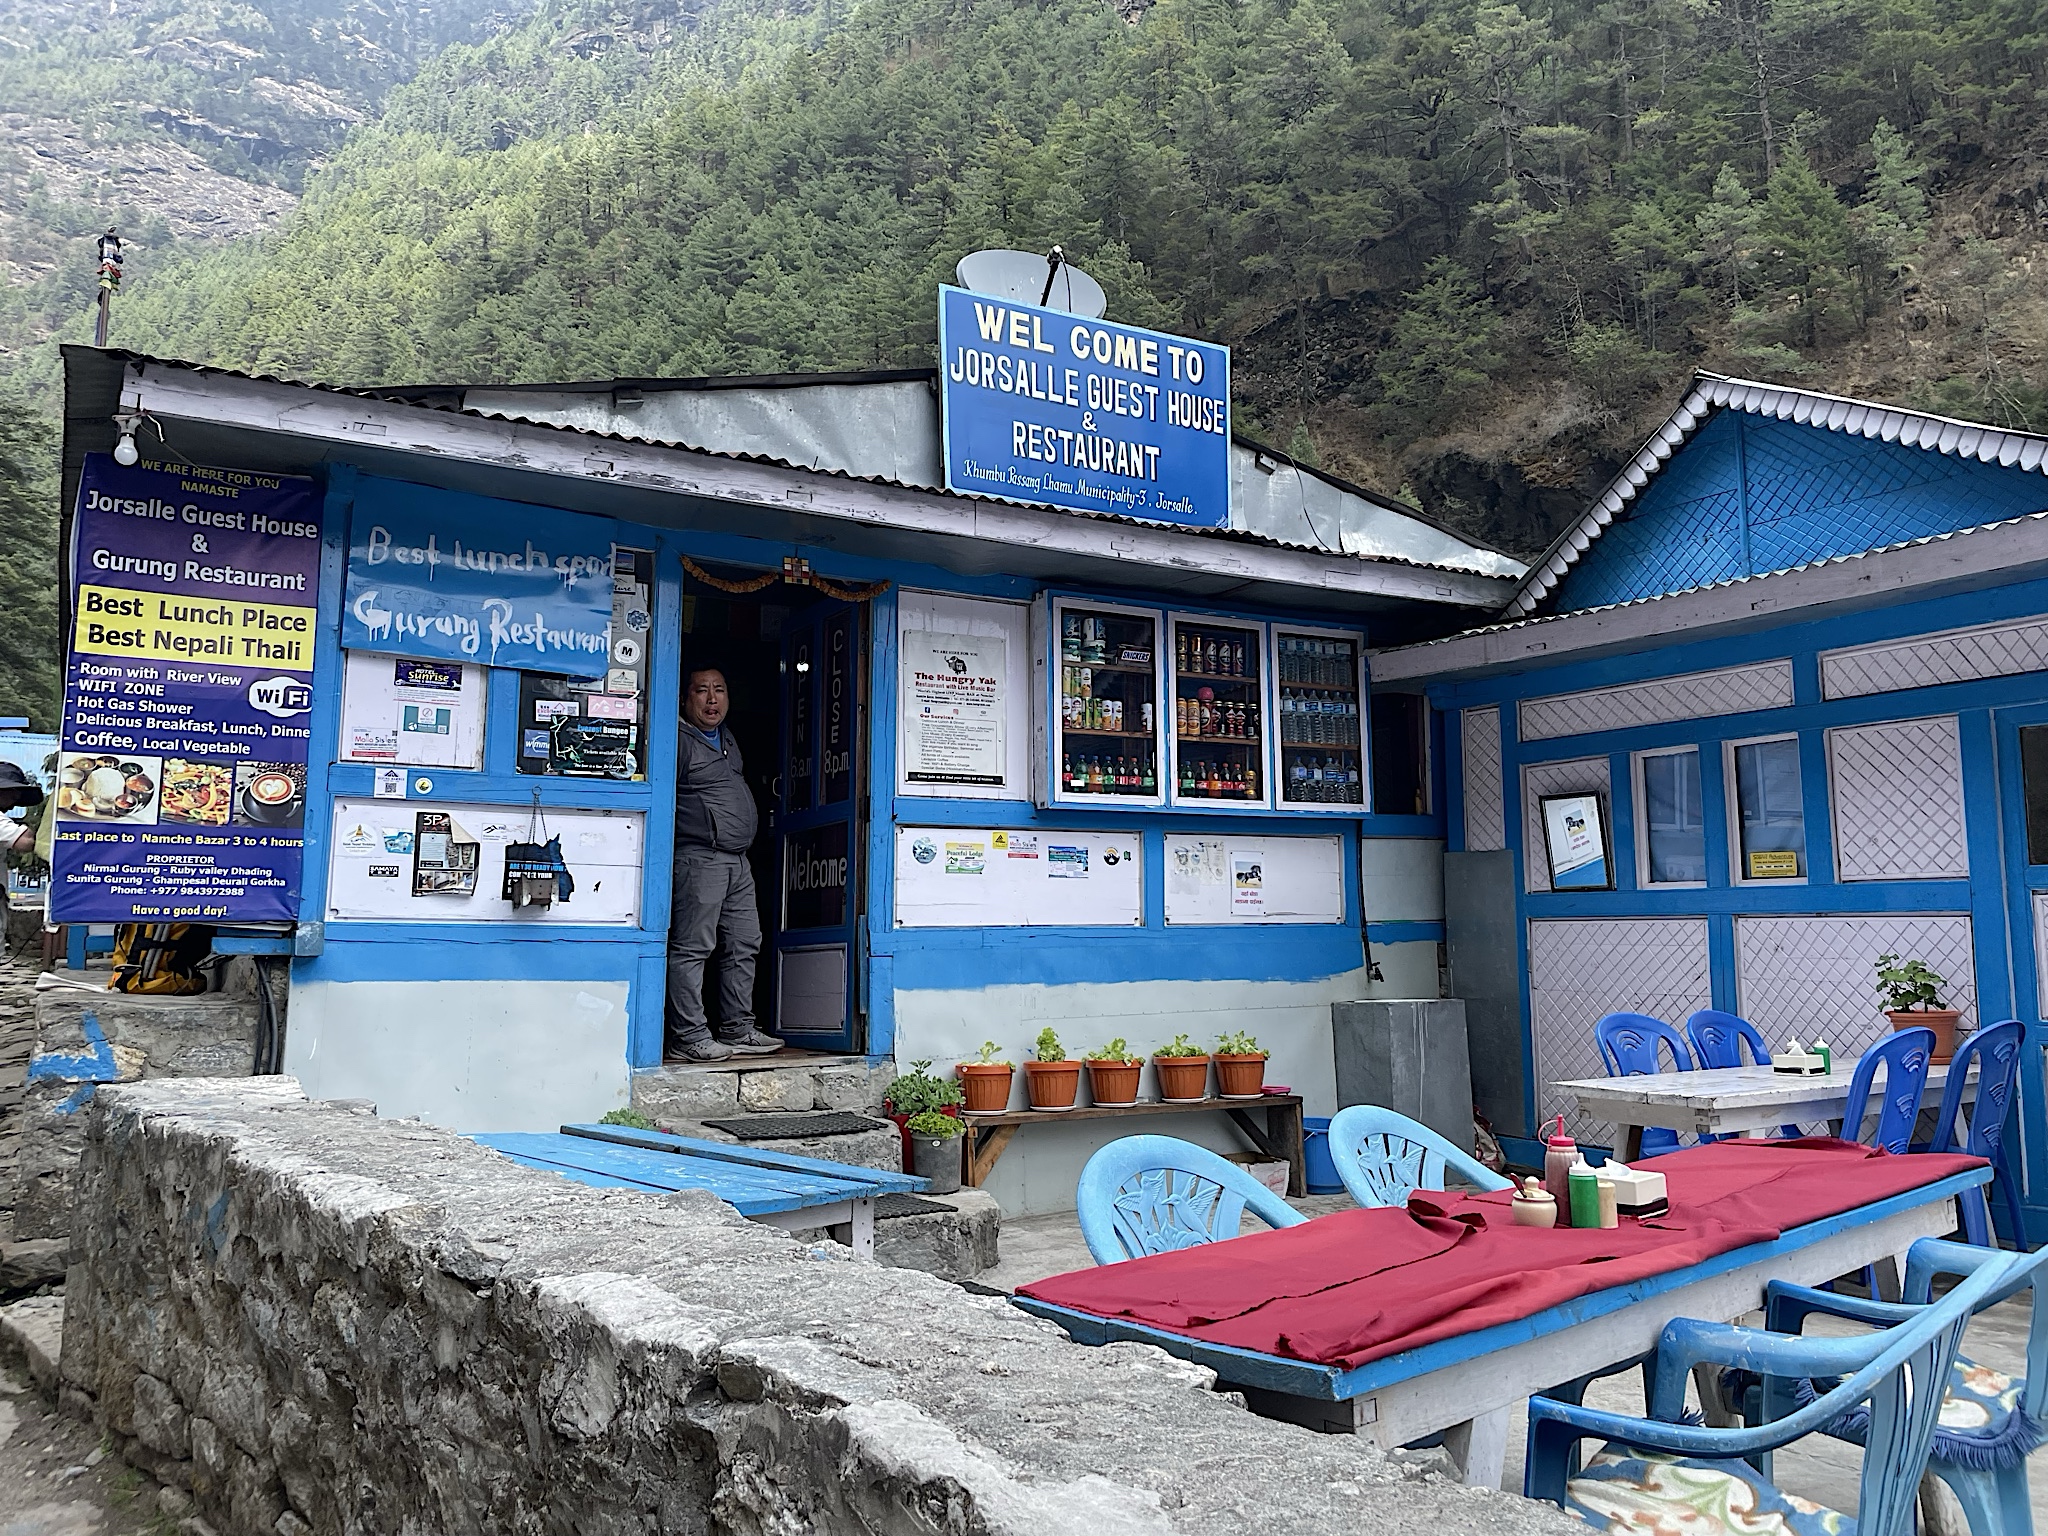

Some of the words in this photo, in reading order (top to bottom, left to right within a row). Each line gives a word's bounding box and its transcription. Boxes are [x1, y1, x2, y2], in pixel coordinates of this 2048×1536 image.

[974, 302, 1054, 353] WEL
[1070, 325, 1158, 376] COME
[1167, 345, 1204, 384] TO
[950, 347, 1078, 407] JORSALLE
[1087, 374, 1159, 421] GUEST
[1168, 390, 1225, 434] HOUSE
[1082, 411, 1098, 432] &
[1013, 420, 1160, 481] RESTAURANT
[141, 459, 161, 471] WE
[164, 463, 188, 476] ARE
[192, 468, 224, 481] HERE
[228, 472, 251, 485] FOR
[255, 476, 280, 490] YOU
[963, 460, 1005, 482] Khumbu
[1042, 472, 1073, 494] Lhamu
[181, 480, 239, 498] NAMASTE
[86, 490, 175, 521] Jorsalle
[182, 505, 245, 531] Guest
[252, 514, 318, 538] House
[192, 534, 209, 554] &
[368, 526, 441, 571] Best
[92, 550, 176, 582] Gurung
[184, 561, 306, 591] Restaurant
[86, 592, 144, 618] Best
[159, 600, 234, 626] Lunch
[242, 608, 308, 632] Place
[88, 624, 145, 648] Best
[154, 630, 234, 656] Nepali
[242, 638, 301, 661] Thali
[482, 597, 613, 665] Restaurant
[1122, 650, 1150, 661] SNICKERS
[80, 663, 122, 678] Room
[126, 666, 158, 680] with
[166, 670, 204, 684] River
[208, 672, 242, 686] View
[914, 672, 934, 680] The
[937, 674, 975, 685] Hungry
[978, 677, 996, 685] Yak
[79, 679, 116, 693] WIFI
[124, 683, 164, 696] ZONE
[830, 629, 844, 744] CLOSE
[78, 696, 104, 709] Hot
[108, 698, 134, 711] Gas
[138, 701, 194, 715] Shower
[76, 712, 142, 728] Delicious
[146, 718, 218, 734] Breakfast,
[222, 722, 268, 738] Lunch,
[74, 732, 137, 750] Coffee,
[143, 738, 179, 750] Local
[182, 740, 250, 755] Vegetable
[55, 830, 82, 841] Last
[84, 832, 118, 844] place
[122, 834, 134, 843] to
[142, 834, 192, 845] Namche
[196, 835, 230, 846] Bazar
[232, 836, 240, 846] 3
[244, 836, 256, 846] to
[260, 836, 268, 846] 4
[270, 837, 304, 848] hours
[146, 854, 214, 864] PROPRIETOR
[789, 845, 848, 892] Welcome
[66, 874, 101, 883] Sunita
[104, 875, 142, 886] Gurung
[152, 876, 209, 887] Ghampesal
[212, 877, 248, 886] Deurali
[250, 878, 286, 887] Gorkha
[84, 864, 119, 873] Nirmal
[122, 864, 160, 875] Gurung
[170, 866, 197, 876] Ruby
[199, 867, 229, 876] valley
[231, 868, 272, 878] Dhading
[110, 886, 147, 895] Phone:
[150, 886, 178, 895] +977
[180, 886, 244, 896] 9843972988
[132, 905, 160, 916] Have
[163, 907, 170, 915] a
[173, 905, 201, 918] good
[204, 905, 228, 918] day!
